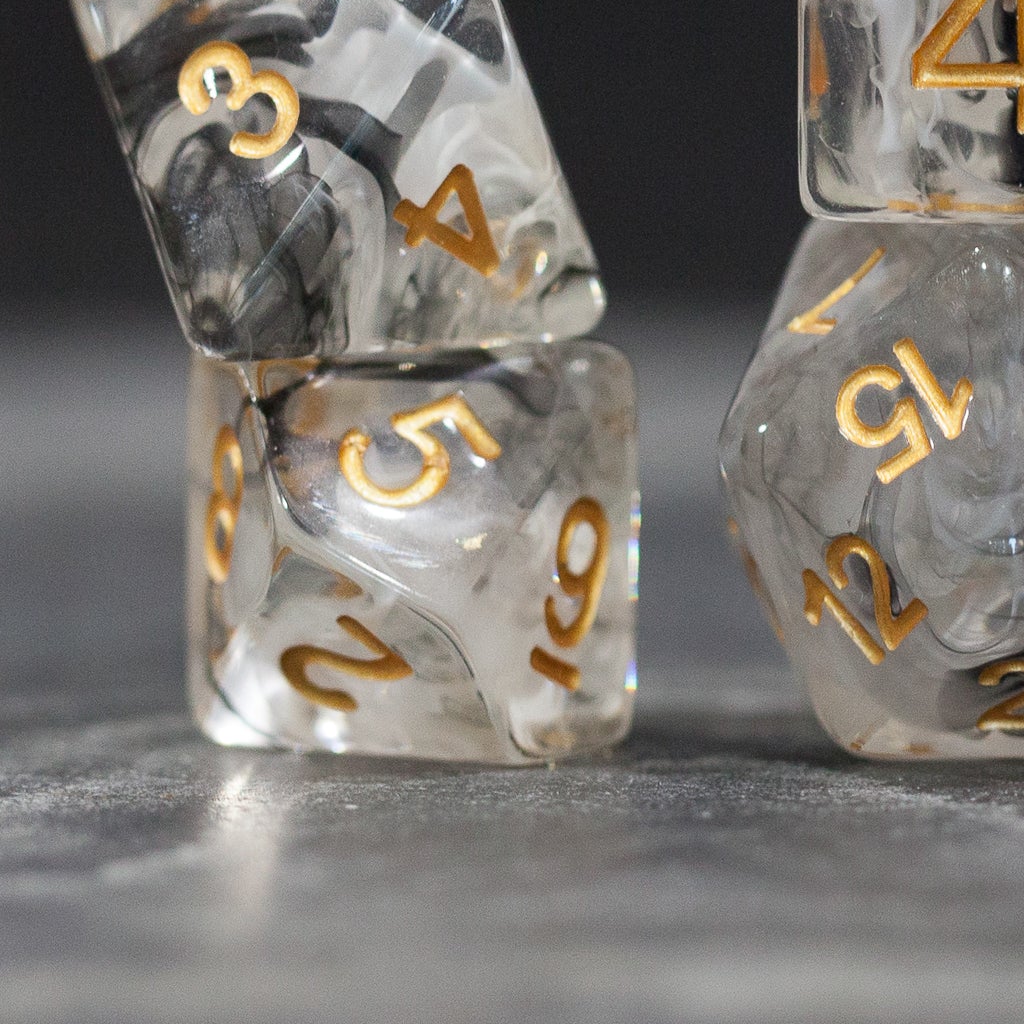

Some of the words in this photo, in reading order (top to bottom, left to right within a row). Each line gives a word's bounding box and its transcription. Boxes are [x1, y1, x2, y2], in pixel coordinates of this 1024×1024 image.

[178, 40, 301, 160] 3
[393, 163, 502, 278] 4
[338, 393, 502, 508] 5
[835, 337, 974, 485] 15
[801, 532, 929, 666] 12
[280, 614, 412, 712] 2
